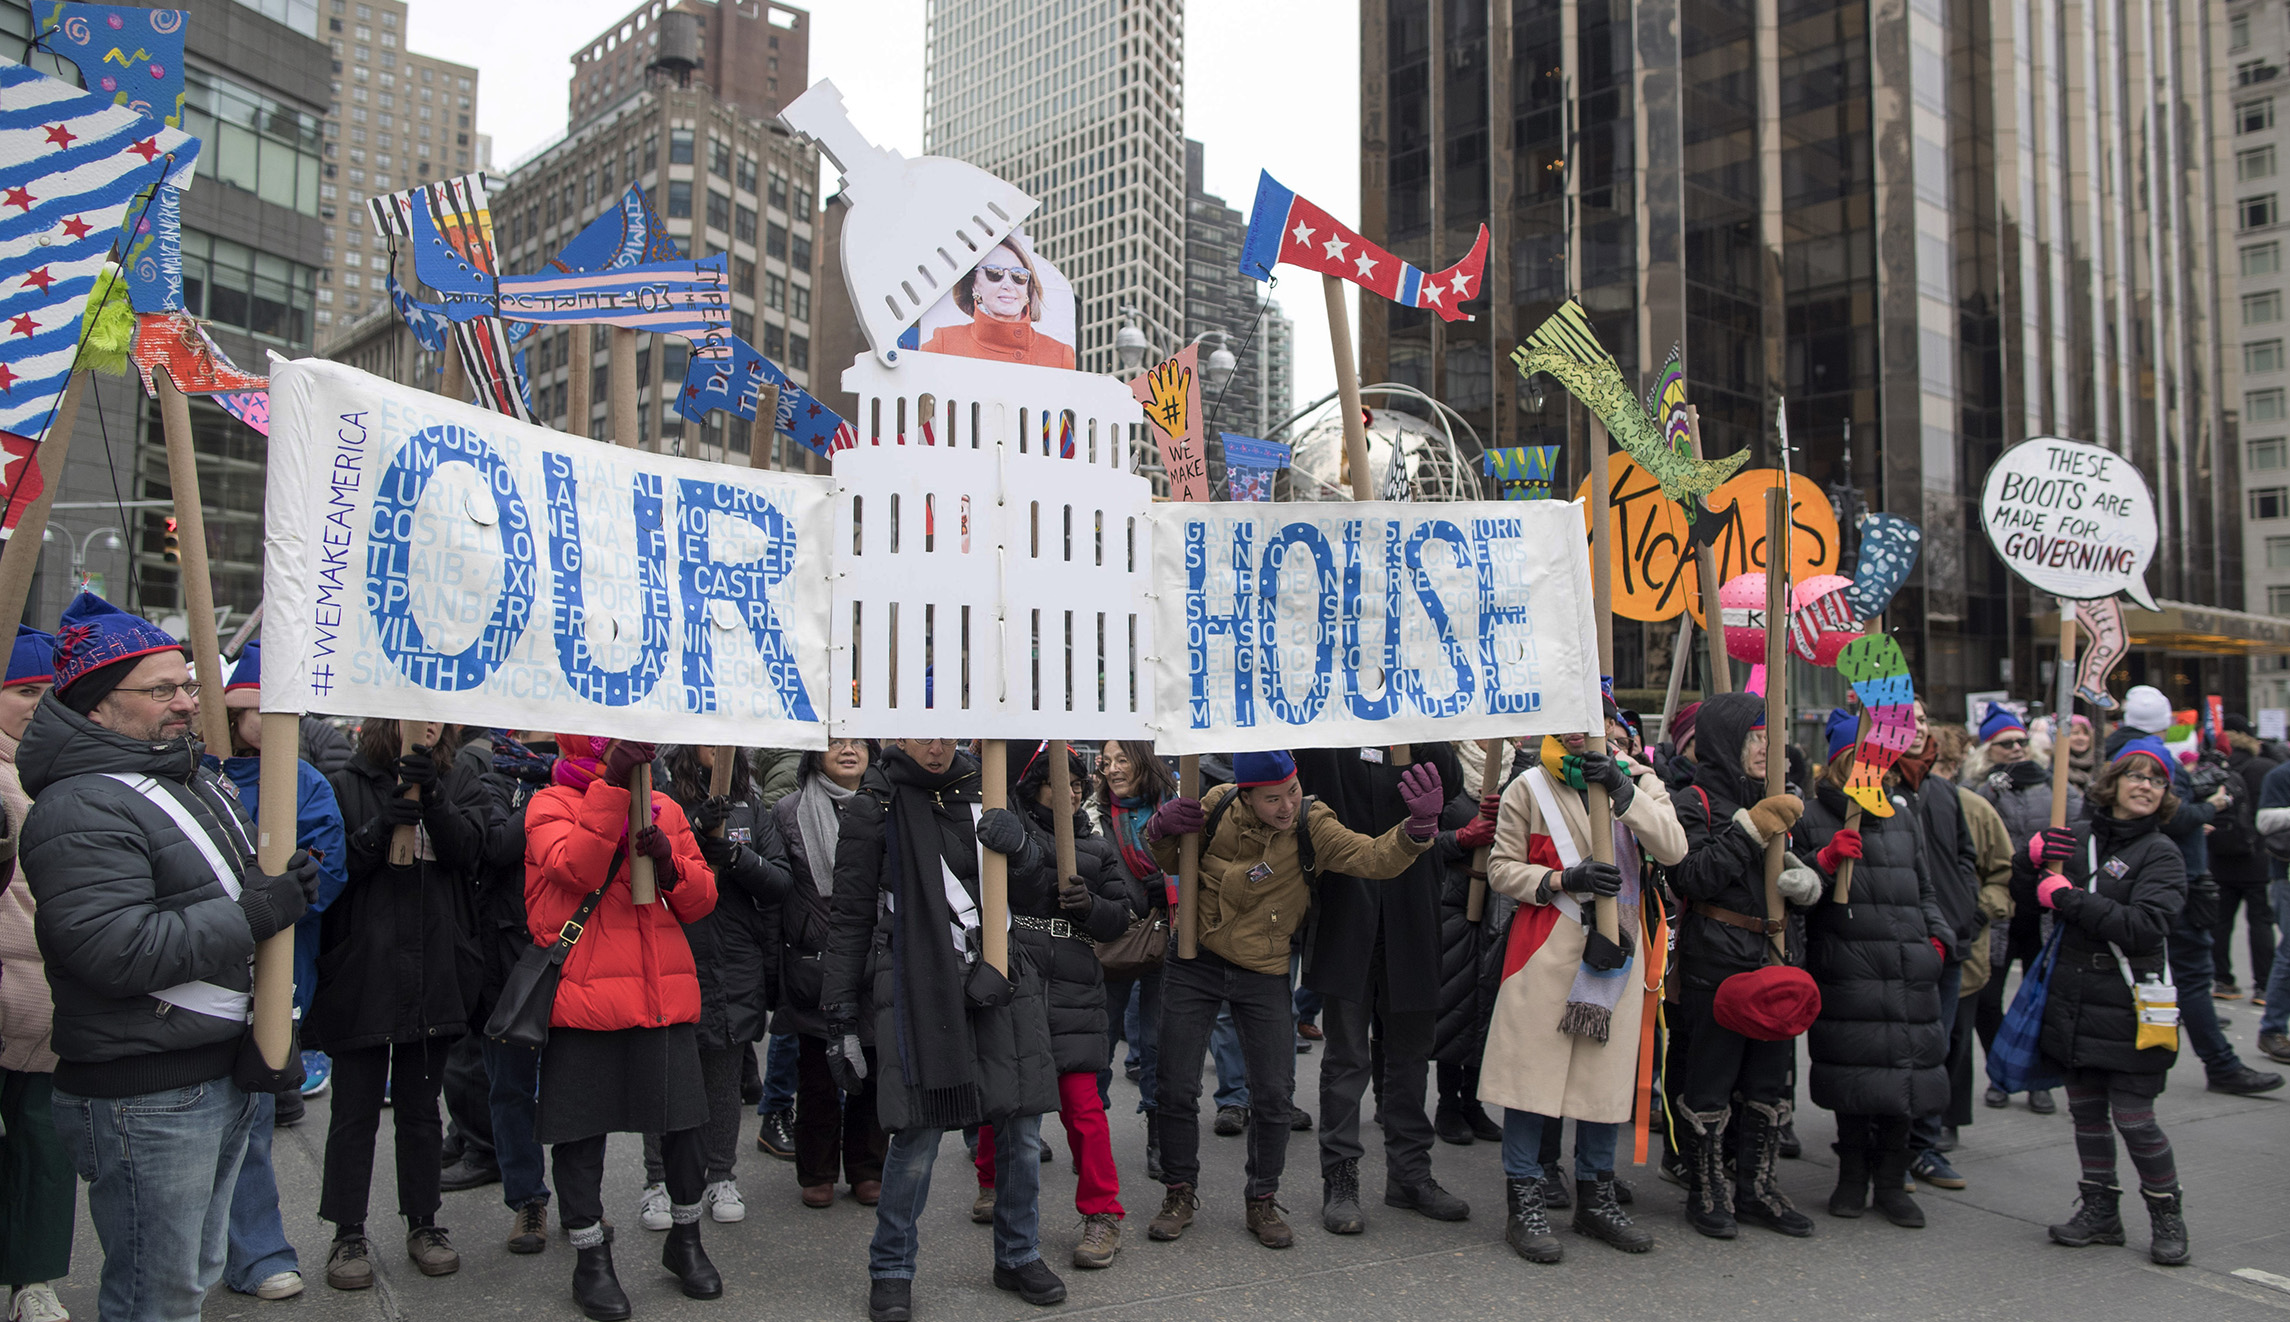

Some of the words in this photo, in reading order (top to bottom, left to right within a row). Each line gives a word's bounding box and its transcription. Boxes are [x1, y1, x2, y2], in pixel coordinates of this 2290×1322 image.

[445, 283, 674, 313] MOTHERFUCKER
[684, 284, 697, 310] THE
[694, 262, 729, 363] IMPEACH
[774, 379, 801, 431] WORK
[381, 397, 524, 467] ESCOBAR
[551, 450, 685, 502] SHALALA
[713, 480, 797, 515] CROW
[1168, 437, 1195, 462] WE
[2047, 447, 2113, 482] THESE
[378, 431, 438, 472] KIM
[664, 497, 798, 544] MORELLE
[1169, 458, 1205, 485] MAKE
[2000, 471, 2088, 510] BOOTS
[2092, 491, 2133, 517] ARE
[372, 467, 478, 518] LURIA
[650, 528, 797, 572] FLETCHER
[1184, 517, 1285, 542] GARCIA
[1317, 517, 1439, 542] PRESSLEY
[1464, 516, 1525, 541] HORN
[1992, 505, 2048, 532] MADE
[2057, 516, 2103, 541] FOR
[310, 410, 369, 697] #WEMAKEAMERICA
[561, 541, 667, 588] GOLDEN
[693, 565, 797, 603] CASTEN
[1185, 542, 1305, 569] STANTON
[1332, 542, 1404, 568] HAYES
[1426, 541, 1528, 566] CISNEROS
[2004, 531, 2136, 576] GOVERNING
[366, 424, 820, 723] OUR
[1184, 518, 1543, 730] HOUSE
[367, 541, 465, 585] TLAIB
[484, 559, 566, 602] AXNE
[583, 577, 685, 620] PORTER
[1185, 569, 1254, 594] LAMB
[1276, 569, 1340, 594] DEAN
[359, 577, 585, 637] SPANBERGER
[618, 614, 799, 661] CUNNINGHAM
[1186, 596, 1295, 620] STEVENS
[1323, 594, 1416, 620] SLOTKIN
[1443, 589, 1532, 615] SCHRIER
[357, 612, 445, 654] WILD
[477, 627, 544, 666] HILL
[573, 638, 676, 681] PAPPAS
[699, 657, 799, 692] NEGUSE
[1187, 621, 1385, 647] OCASIO-CORTEZ
[1188, 648, 1305, 675] DELGADO
[1331, 644, 1410, 671] ROSEN
[1437, 638, 1539, 666] BRINDISI
[351, 650, 459, 691] SMITH
[483, 663, 607, 706] MCBATH
[627, 678, 734, 717] HARDER
[751, 690, 798, 721] COX
[1189, 675, 1232, 701] LEE
[1392, 667, 1460, 694] OMAR
[1483, 662, 1542, 689] ROSE
[1189, 696, 1354, 727] MALINOWSKI
[1385, 688, 1543, 718] UNDERWOOD
